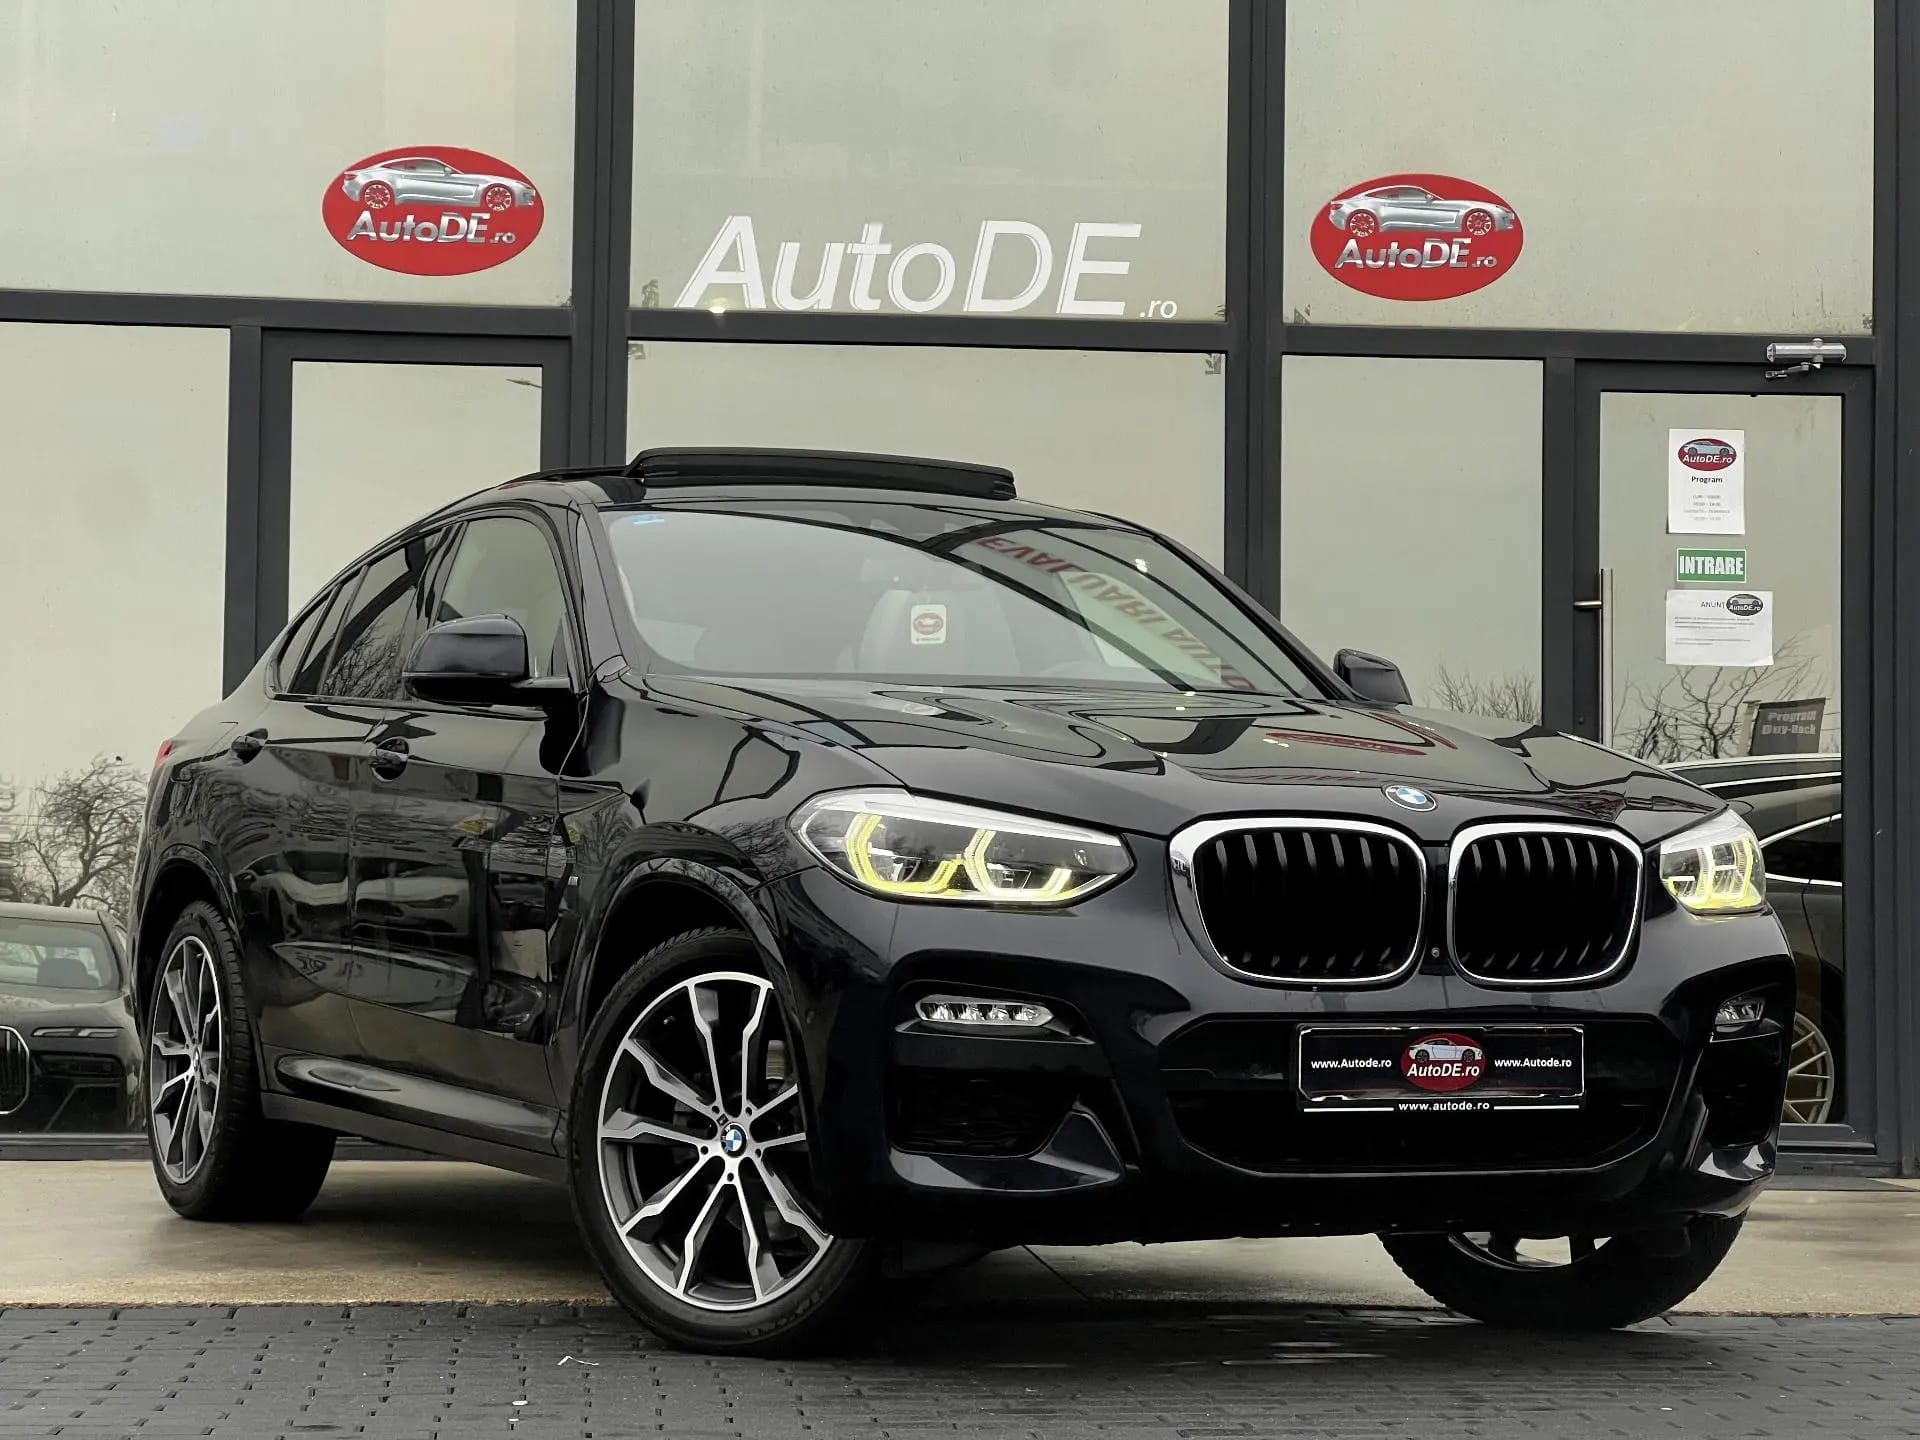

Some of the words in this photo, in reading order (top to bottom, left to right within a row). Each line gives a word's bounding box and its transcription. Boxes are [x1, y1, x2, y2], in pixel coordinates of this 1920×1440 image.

[1691, 476, 1723, 484] Program
[1679, 555, 1744, 575] INTRARE
[1311, 1057, 1392, 1069] www.Autode.ro
[1494, 1056, 1572, 1068] www.Autode.ro
[1407, 1063, 1480, 1078] AutoDE.ro
[1398, 1101, 1490, 1112] www.autode.ro
